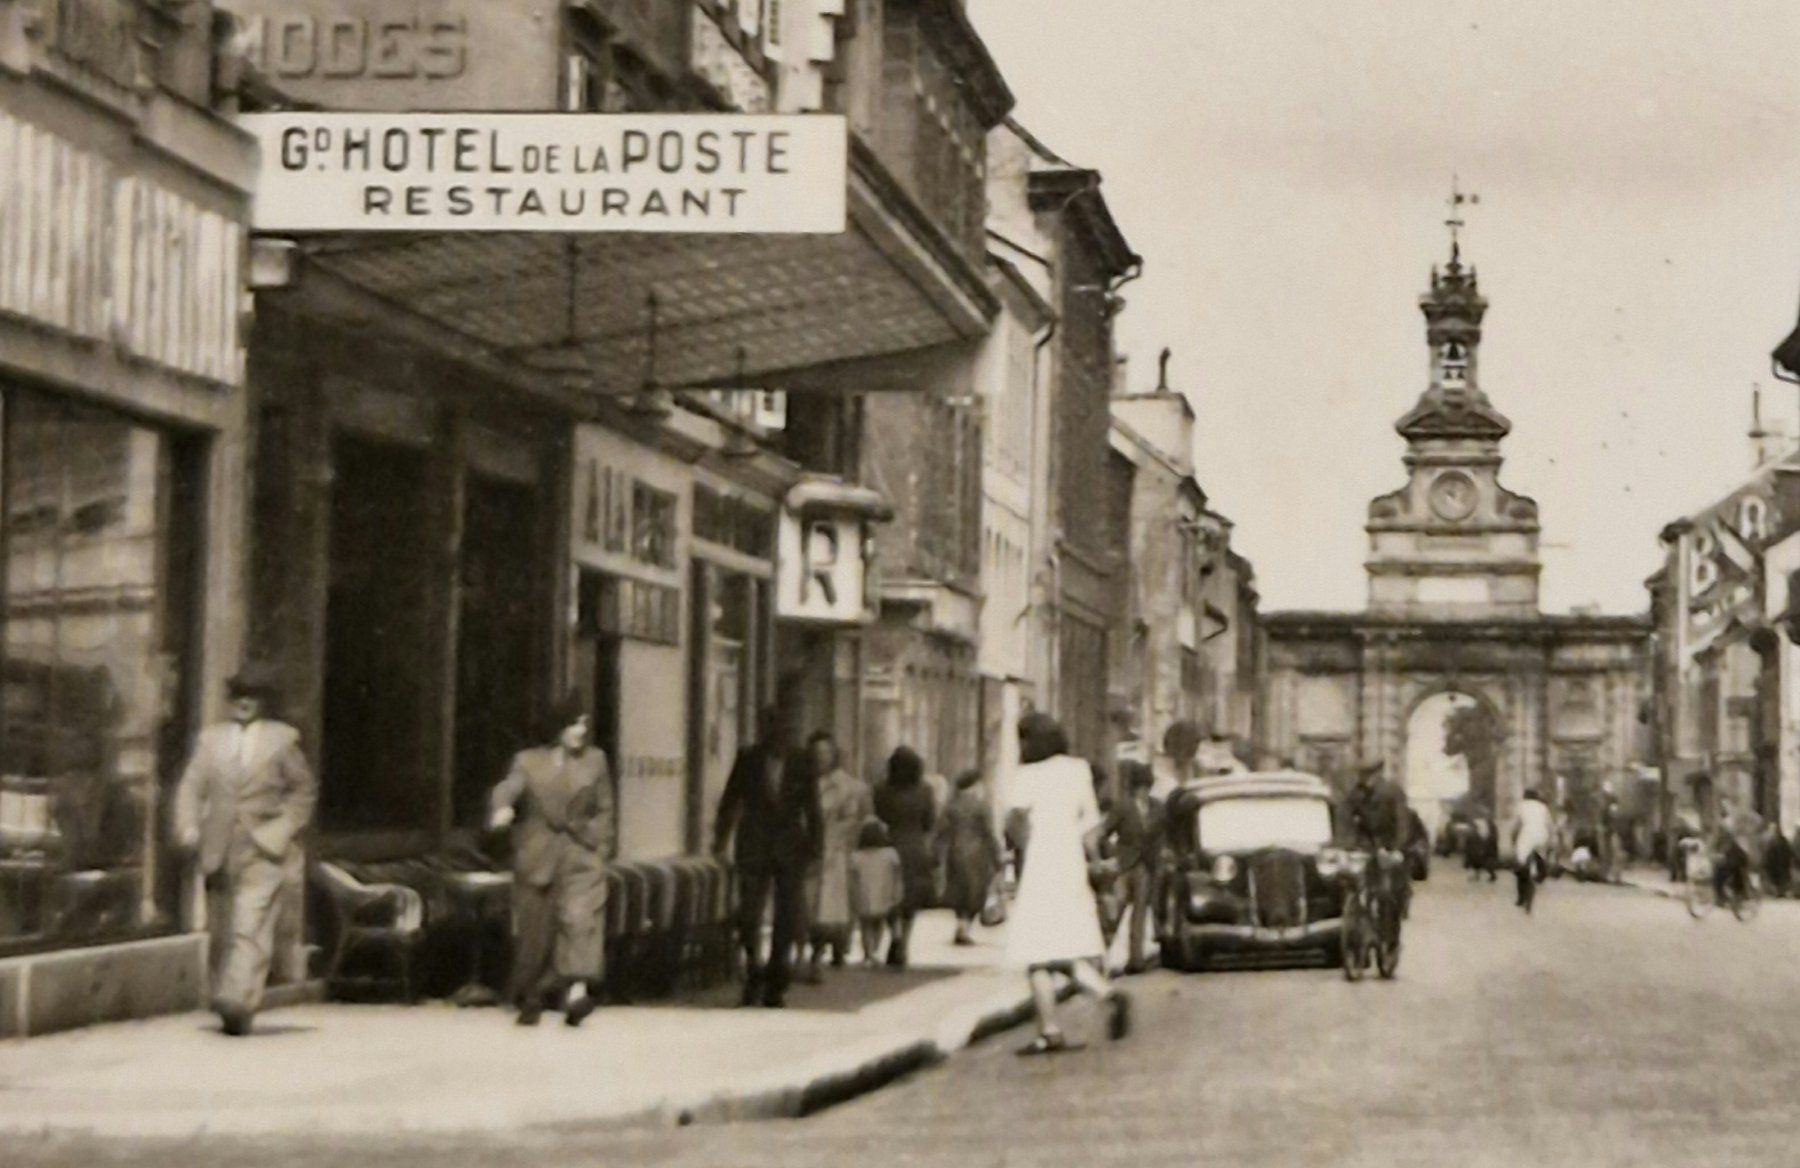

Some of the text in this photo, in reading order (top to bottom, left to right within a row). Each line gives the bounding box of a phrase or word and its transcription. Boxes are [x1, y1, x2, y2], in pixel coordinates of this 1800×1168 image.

[246, 15, 467, 80] ODES
[342, 127, 515, 173] HOTEL
[521, 143, 561, 174] DE
[573, 144, 611, 174] LA
[621, 129, 791, 175] POSTE
[363, 184, 749, 217] RESTAURANT
